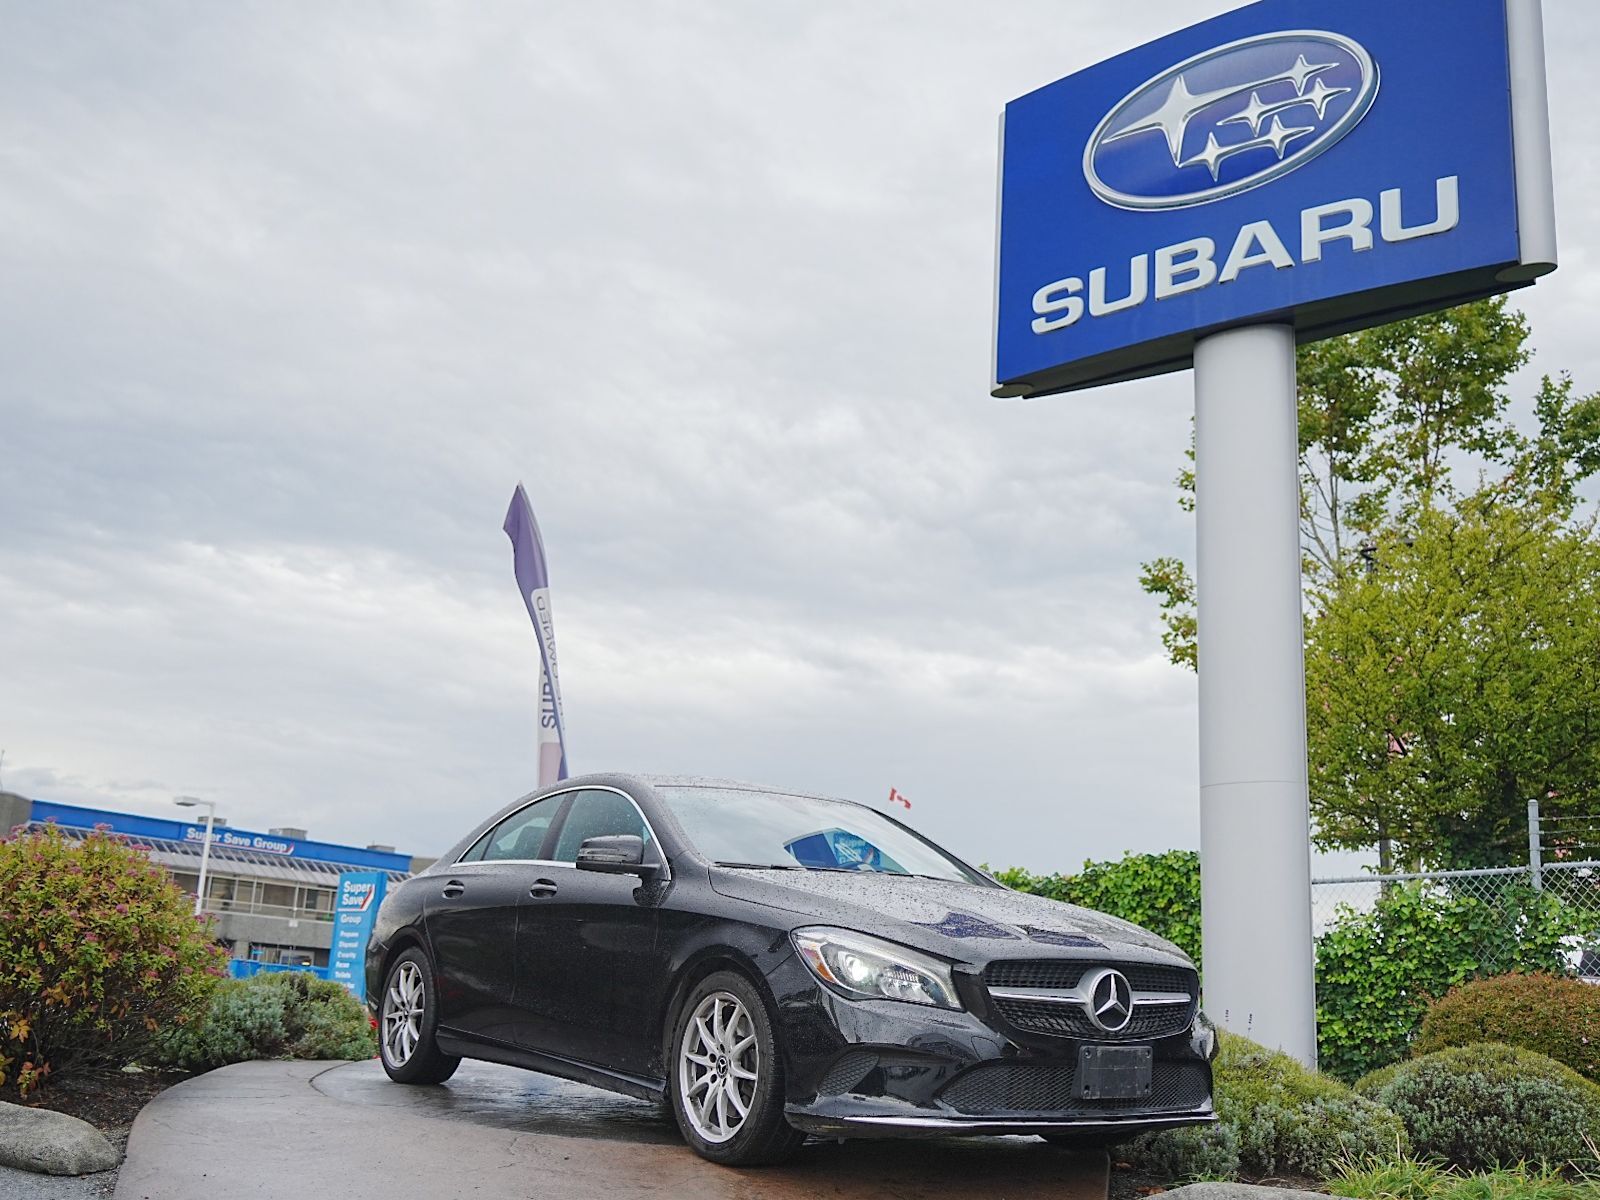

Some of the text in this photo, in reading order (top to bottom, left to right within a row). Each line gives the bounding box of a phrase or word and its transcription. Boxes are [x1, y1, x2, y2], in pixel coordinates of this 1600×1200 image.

[1031, 175, 1460, 335] SUBARU
[223, 833, 251, 846] Save
[253, 837, 287, 853] Group
[343, 881, 371, 895] Super
[342, 894, 364, 905] Save
[340, 914, 361, 924] Group
